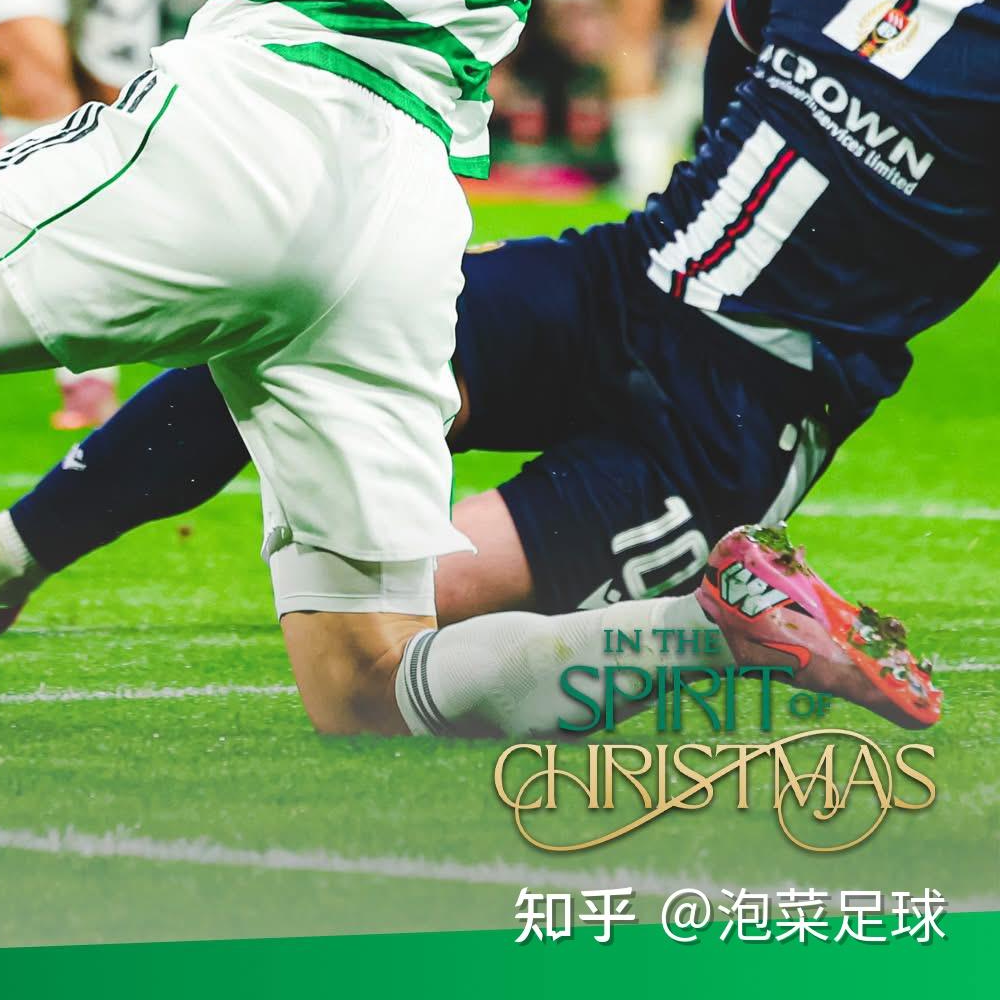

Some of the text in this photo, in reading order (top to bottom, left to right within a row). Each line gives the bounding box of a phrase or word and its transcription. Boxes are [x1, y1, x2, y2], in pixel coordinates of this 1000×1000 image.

[771, 47, 935, 181] CROWN
[863, 149, 920, 196] limited
[611, 495, 709, 600] 10
